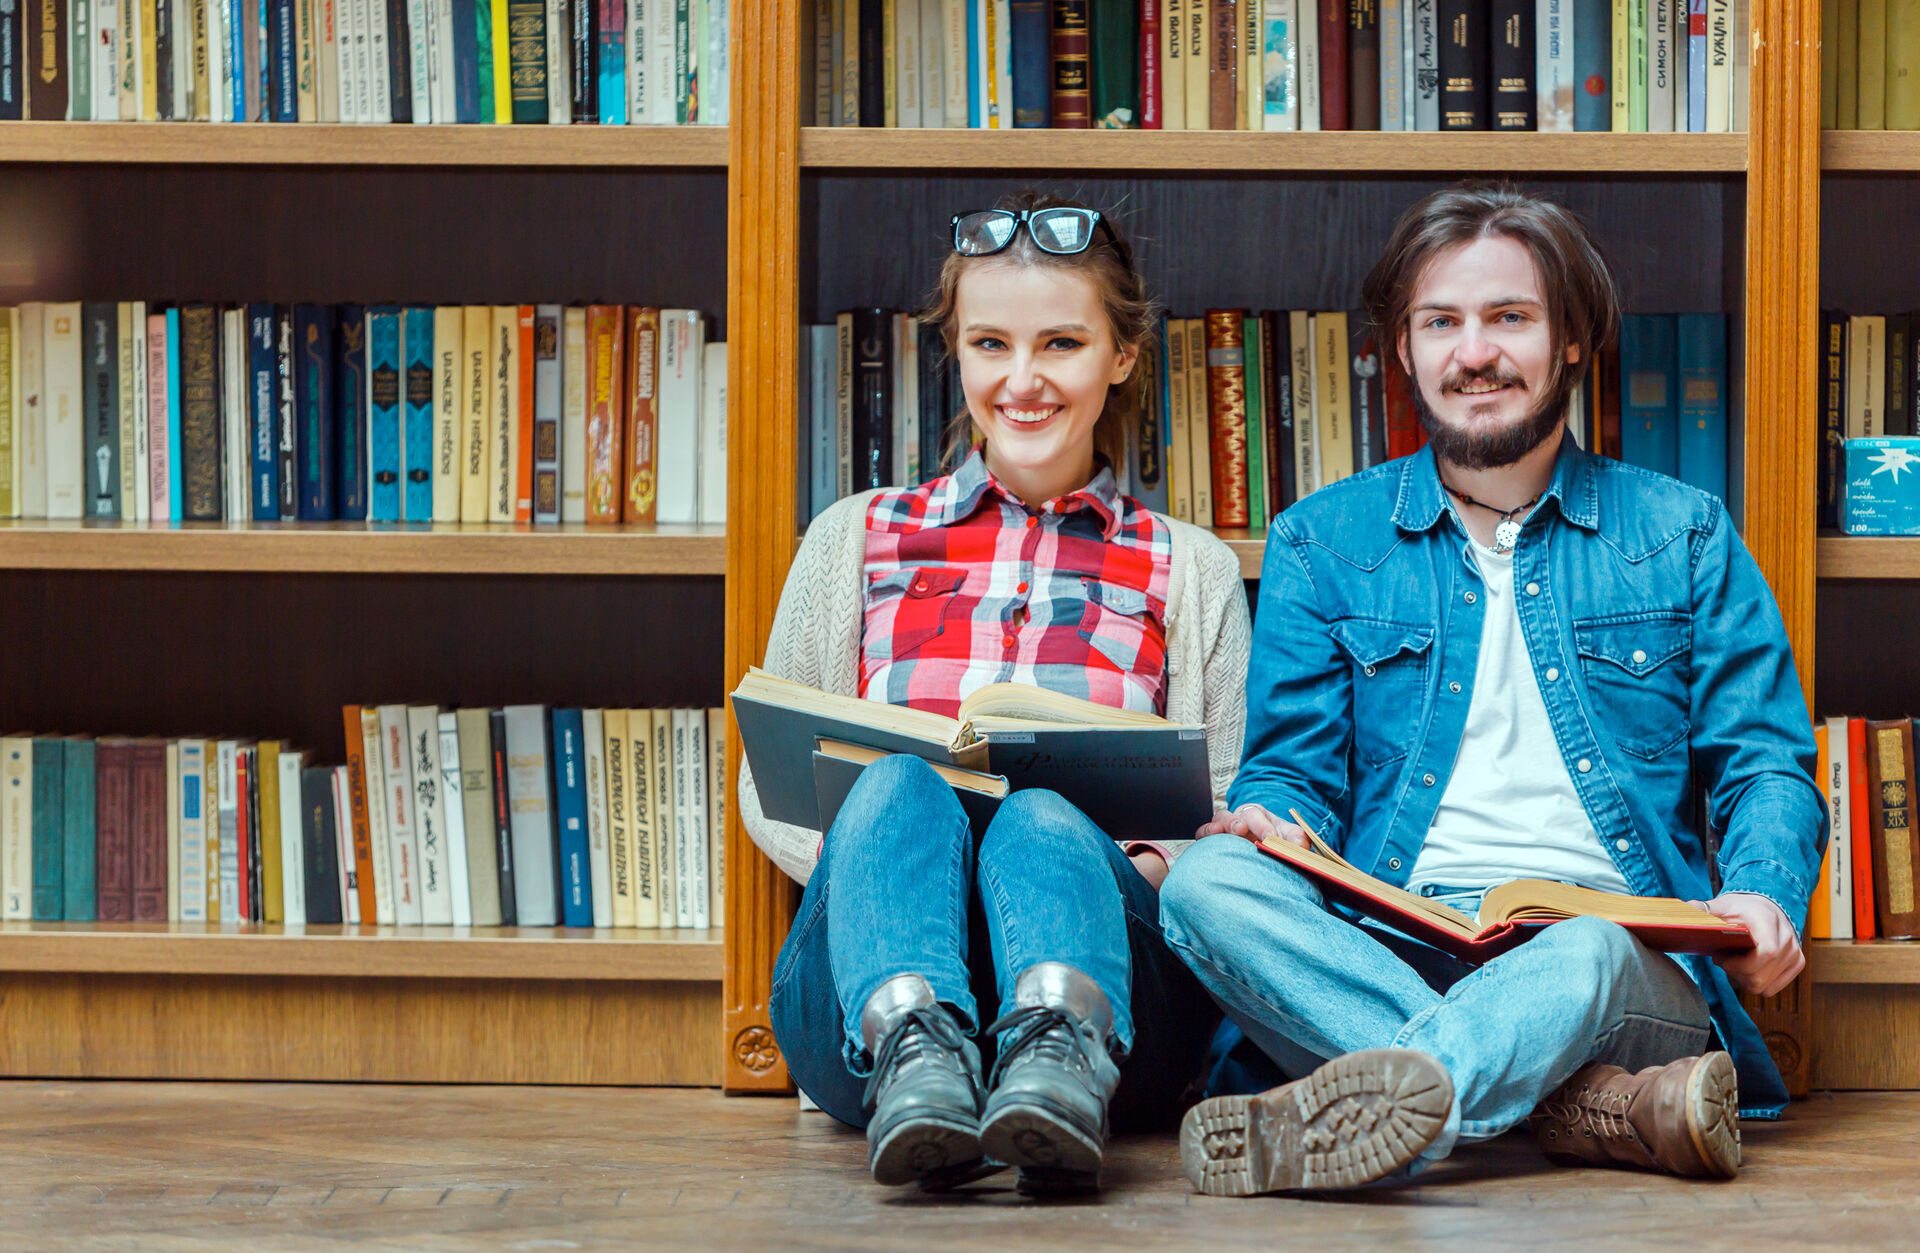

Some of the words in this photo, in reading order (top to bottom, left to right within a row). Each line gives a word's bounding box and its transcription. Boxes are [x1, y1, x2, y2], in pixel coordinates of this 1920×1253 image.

[1679, 0, 1687, 24] РОМ
[1171, 16, 1179, 58] ІСТОРІЯ
[1193, 13, 1201, 56] ІСТОРІЯ
[1714, 16, 1727, 66] КУЖІЛЬ
[1658, 39, 1666, 88] СИМОН
[1851, 524, 1867, 532] 100
[1888, 817, 1906, 827] XIX
